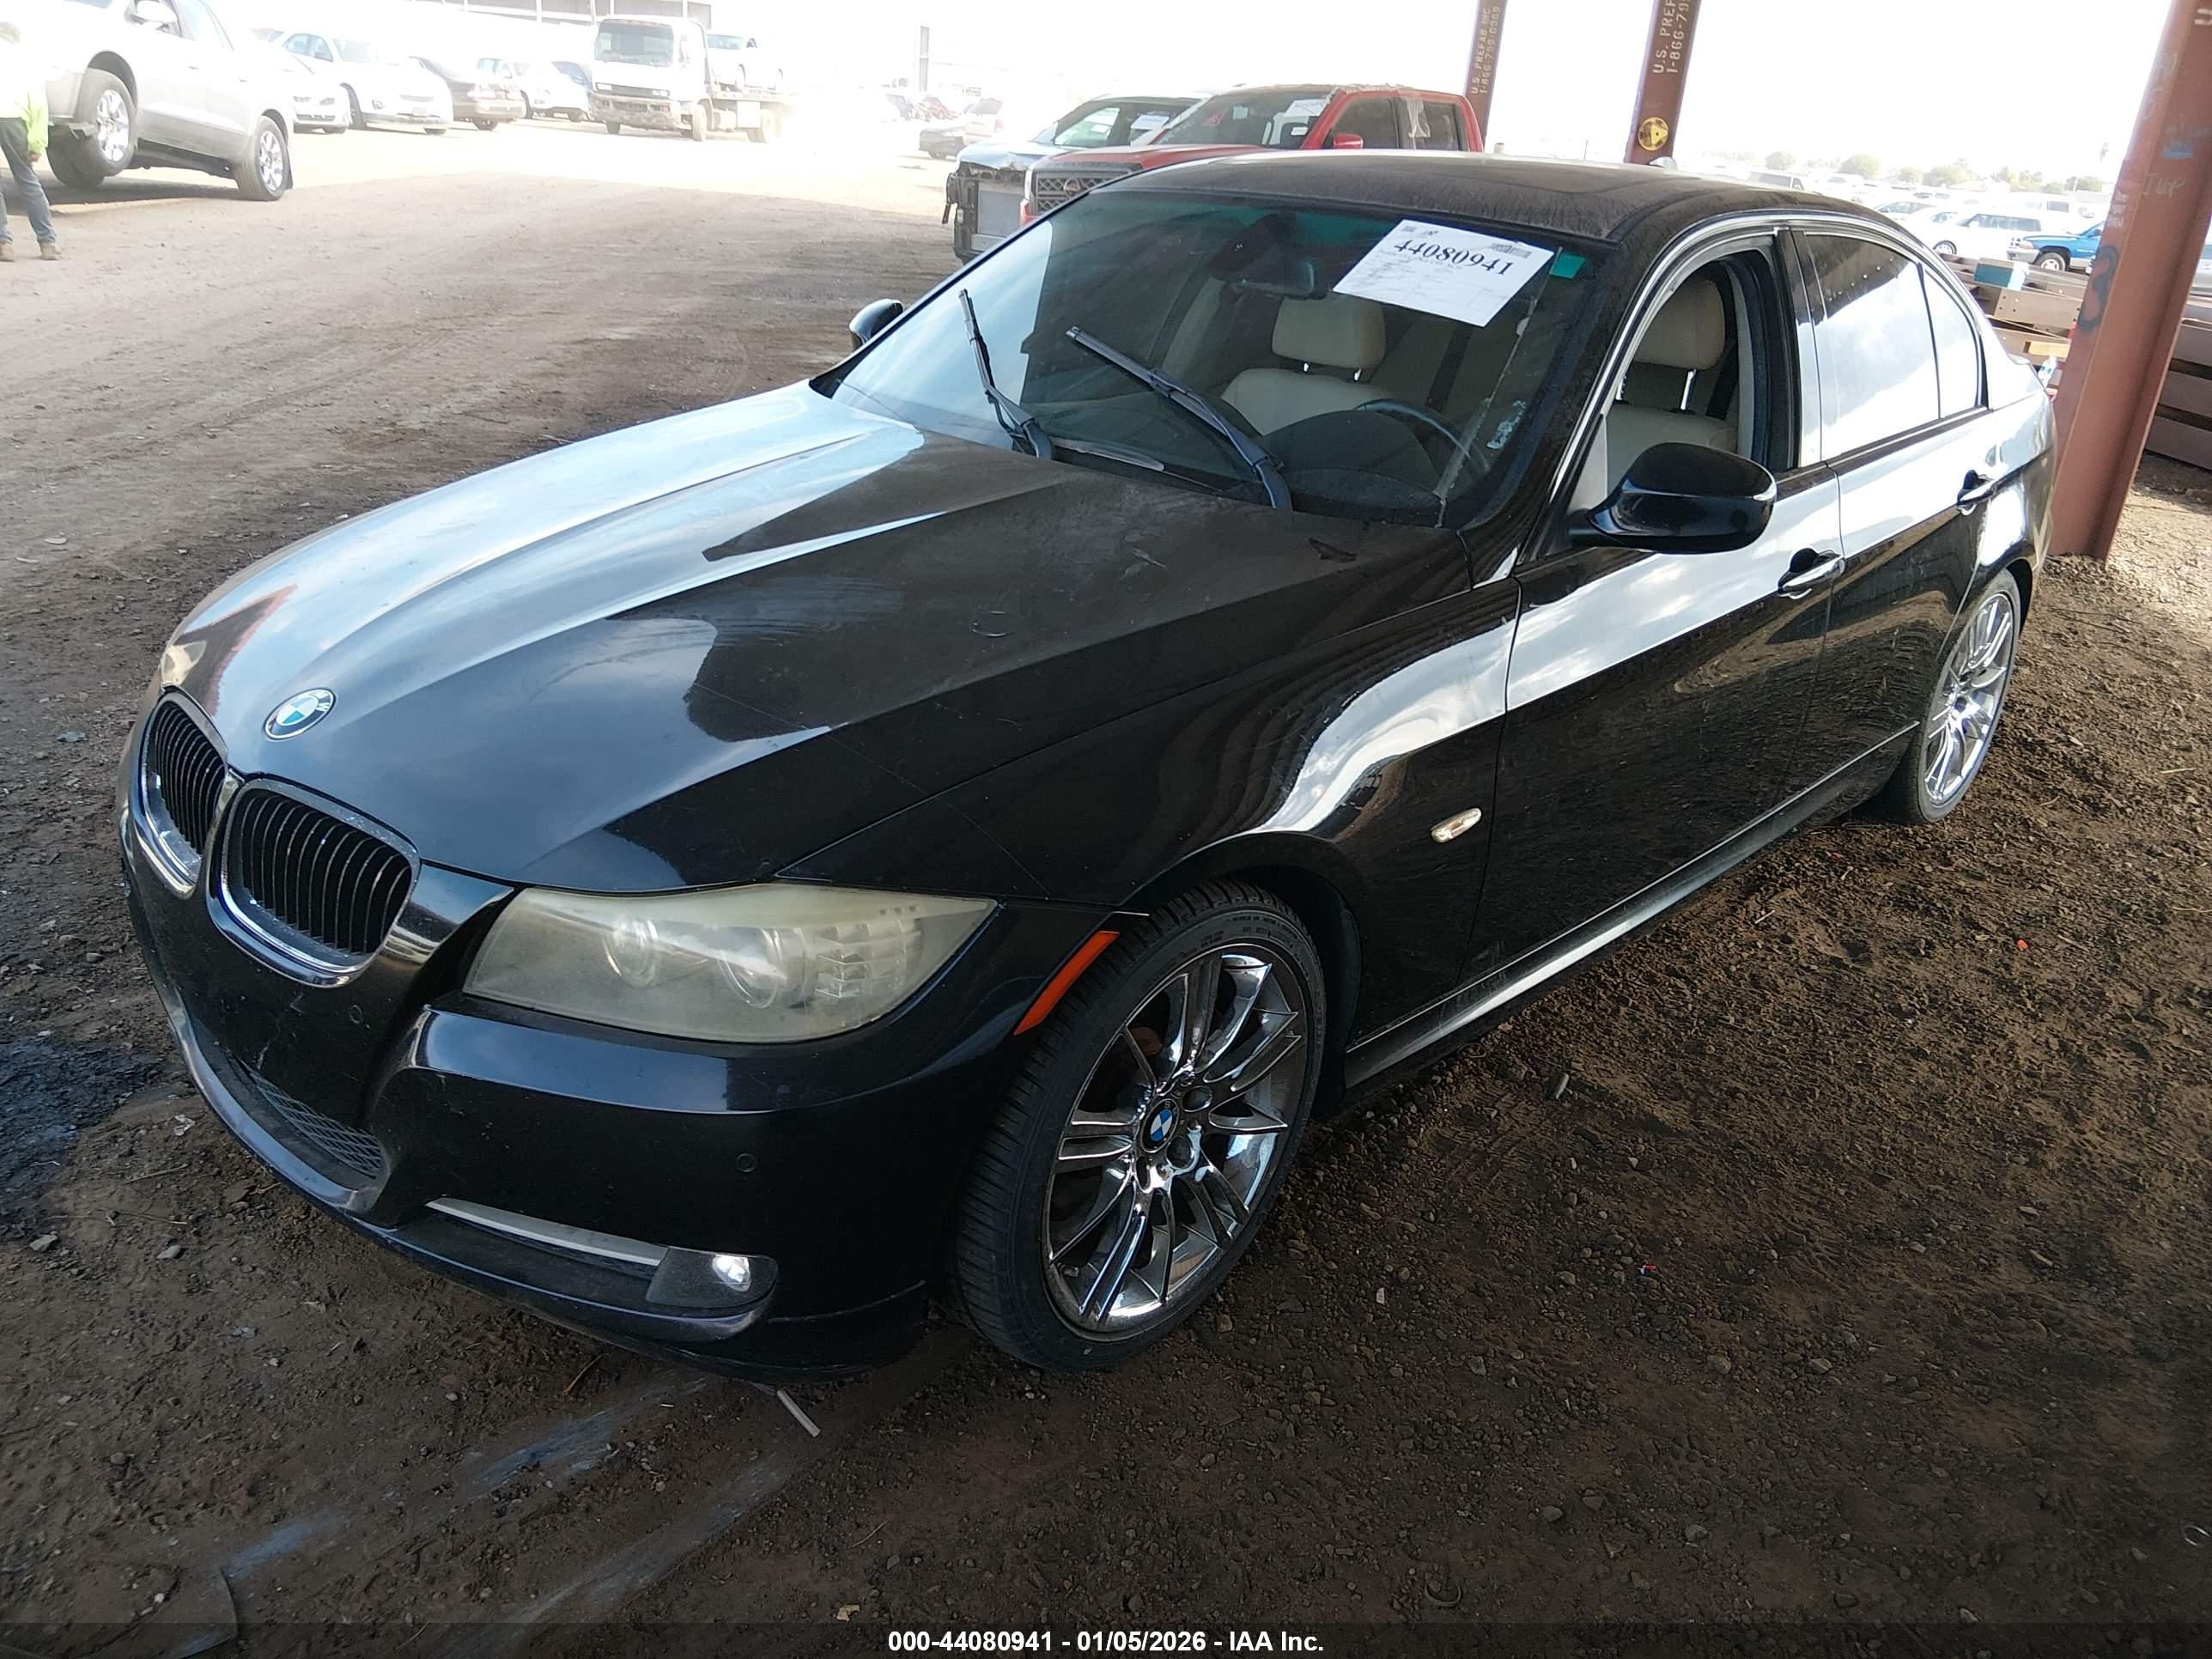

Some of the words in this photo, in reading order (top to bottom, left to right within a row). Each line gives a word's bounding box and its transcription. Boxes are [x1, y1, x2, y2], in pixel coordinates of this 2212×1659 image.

[1474, 27, 1488, 70] PREFAB
[1666, 0, 1690, 73] 1-866-79
[1652, 45, 1668, 73] U.S.
[1470, 76, 1481, 94] U.S.
[1395, 240, 1514, 276] 44080941
